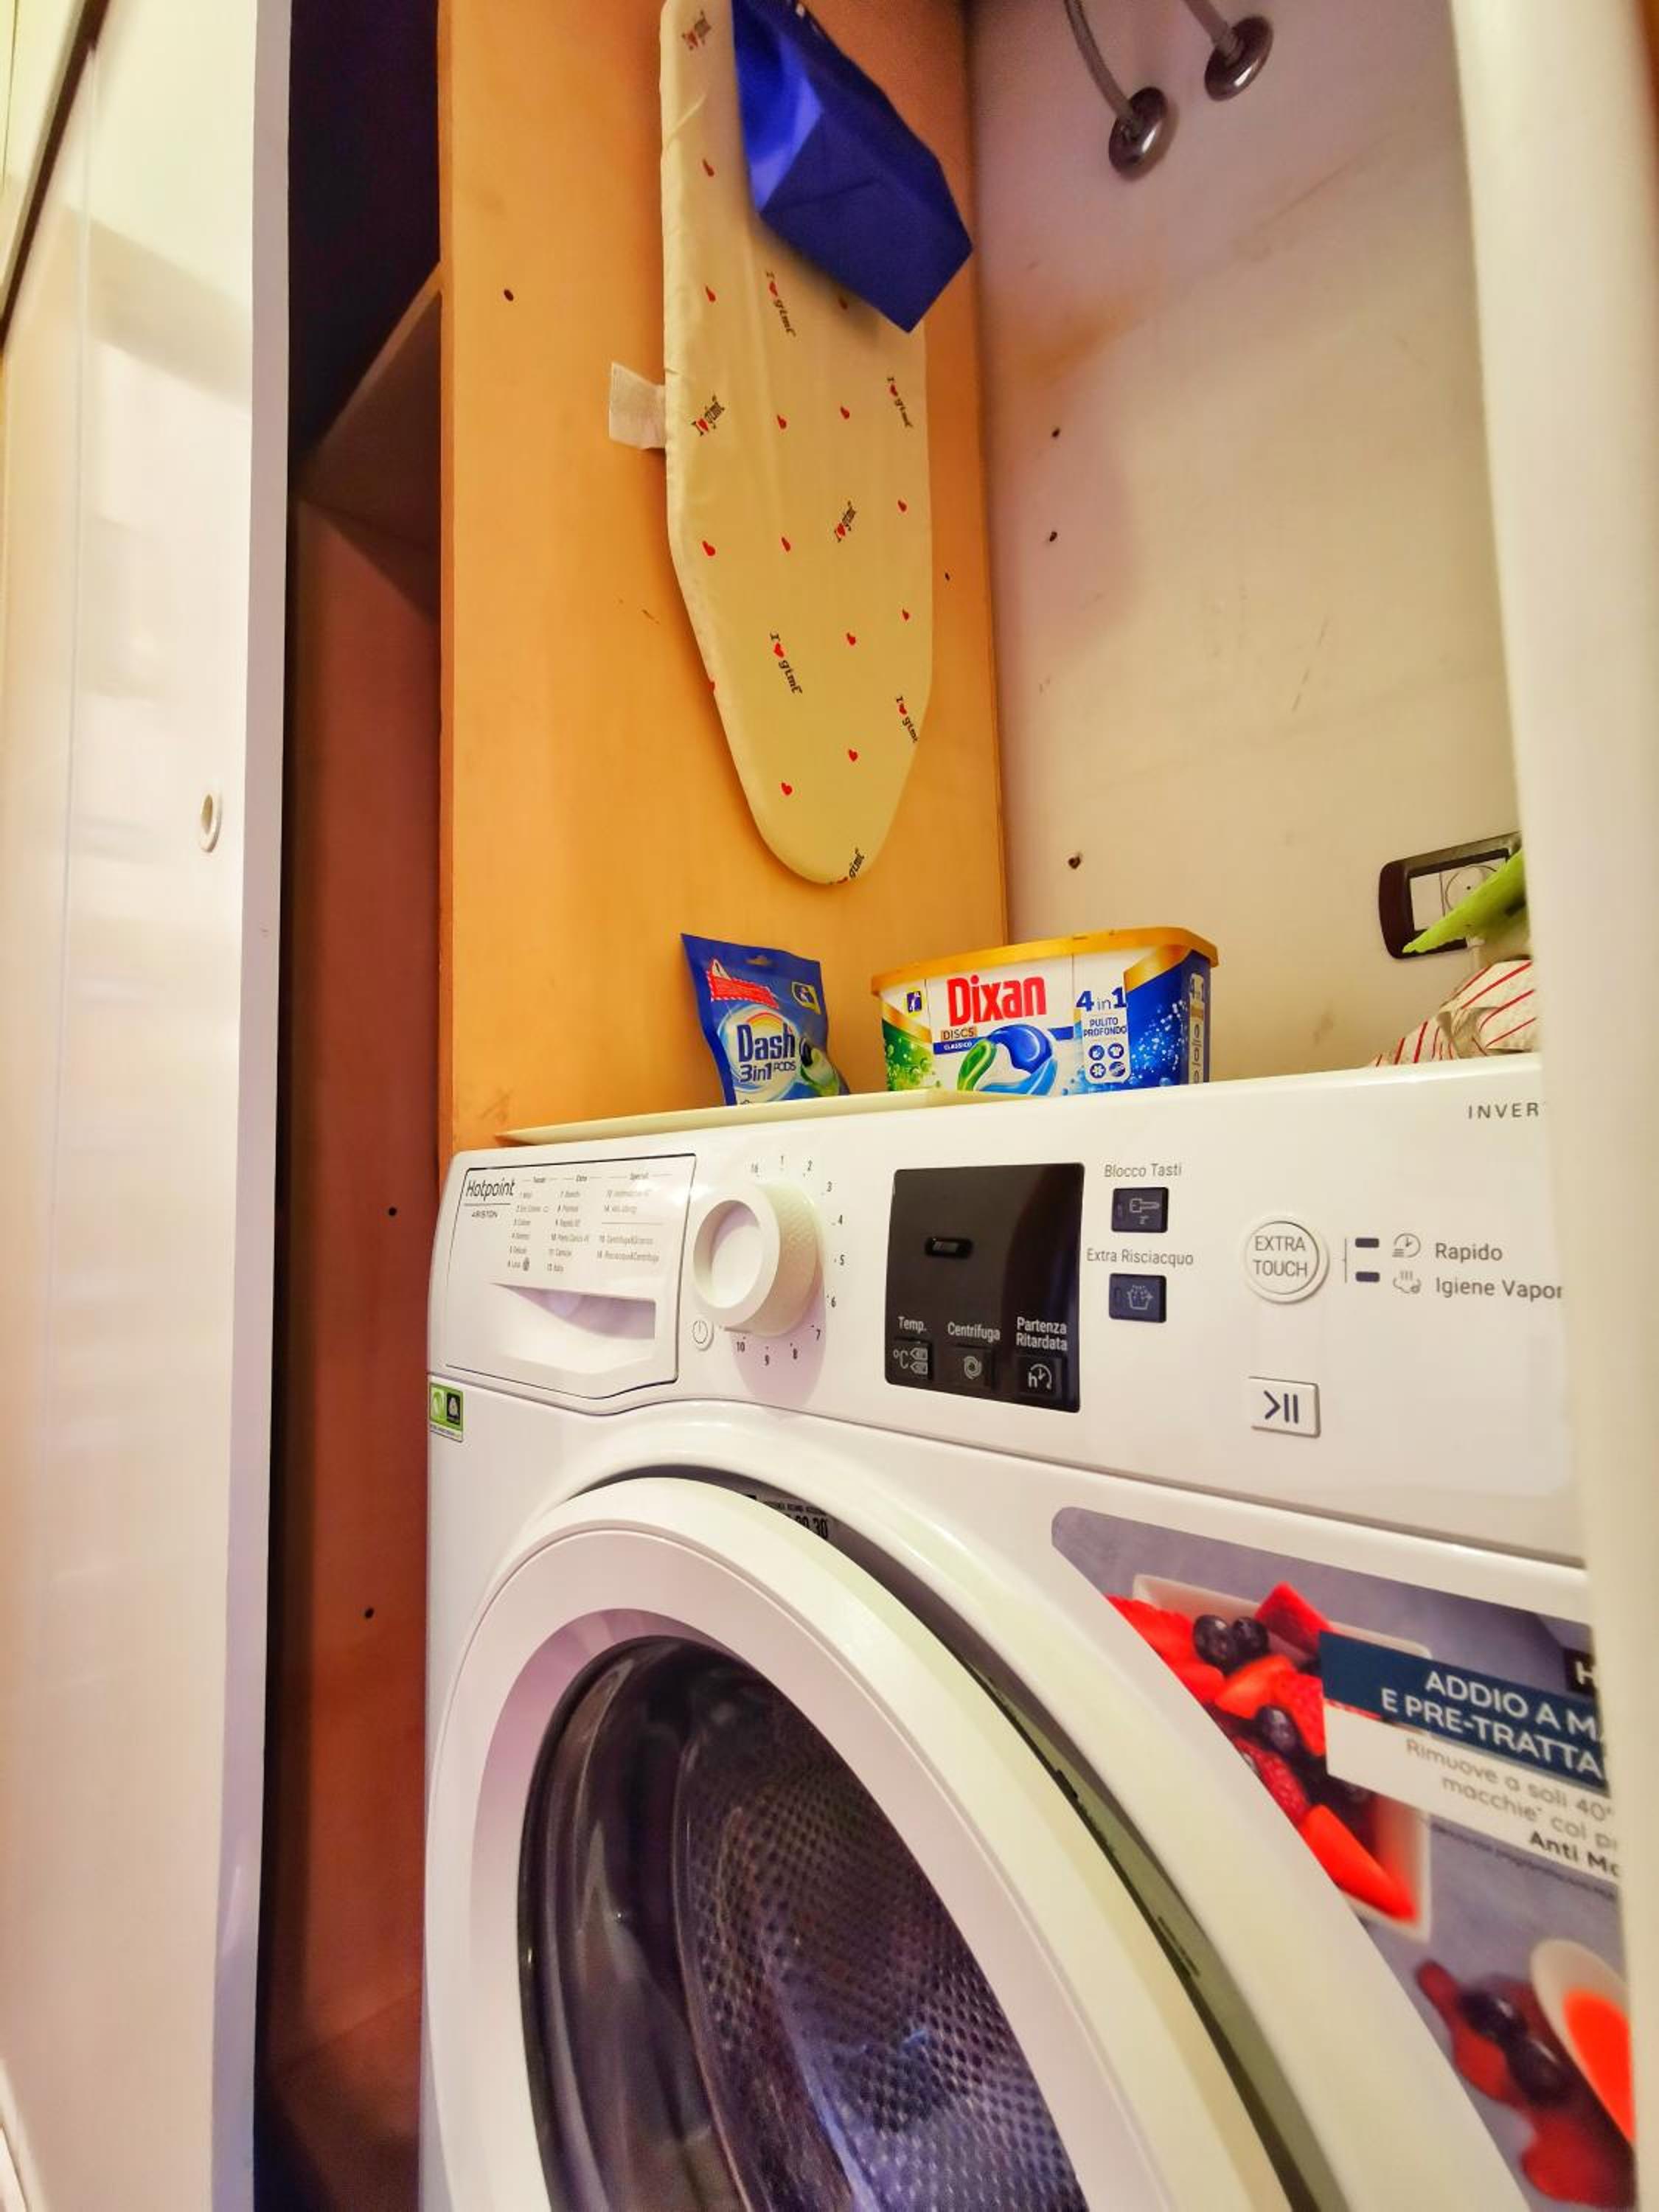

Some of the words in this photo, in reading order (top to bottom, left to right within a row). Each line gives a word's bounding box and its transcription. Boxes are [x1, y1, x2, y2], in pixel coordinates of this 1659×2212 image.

[946, 974, 1047, 1026] Dixan
[1083, 1026, 1127, 1037] PROFONDO
[1089, 1017, 1119, 1027] PULITO
[737, 1022, 796, 1062] Dash
[943, 1027, 974, 1040] DISCS
[943, 1042, 973, 1051] CLASSICO
[740, 1062, 773, 1083] 3in1
[773, 1062, 796, 1072] PODS
[807, 1160, 813, 1172] 2
[1105, 1164, 1147, 1178] Blocco
[1151, 1161, 1182, 1178] Tasti
[465, 1177, 515, 1201] Hotpoint
[826, 1182, 832, 1192] 3
[838, 1214, 844, 1225] 4
[1254, 1235, 1307, 1252] EXTRA
[1434, 1242, 1503, 1264] Rapido
[839, 1254, 846, 1266] 5
[1087, 1248, 1118, 1263] Extra
[1121, 1248, 1194, 1267] Risciacquo
[1253, 1259, 1308, 1278] TOUCH
[1435, 1276, 1495, 1298] Igiene
[830, 1297, 837, 1308] 6
[897, 1315, 928, 1334] Temp.
[947, 1321, 1001, 1343] Centrifuga
[1016, 1315, 1068, 1335] Partenza
[815, 1329, 821, 1340] 7
[1015, 1332, 1068, 1352] Ritardata
[736, 1341, 745, 1352] 10
[1425, 1670, 1529, 1720] ADDIO
[1535, 1705, 1562, 1731] A
[1381, 1688, 1398, 1713] E
[1405, 1694, 1603, 1779] PRE-TRATTA
[1406, 1738, 1498, 1783] Rimuove
[1504, 1776, 1521, 1792] a
[1527, 1784, 1568, 1809] soli
[1551, 1817, 1586, 1840] col
[1530, 1830, 1579, 1863] Anti
